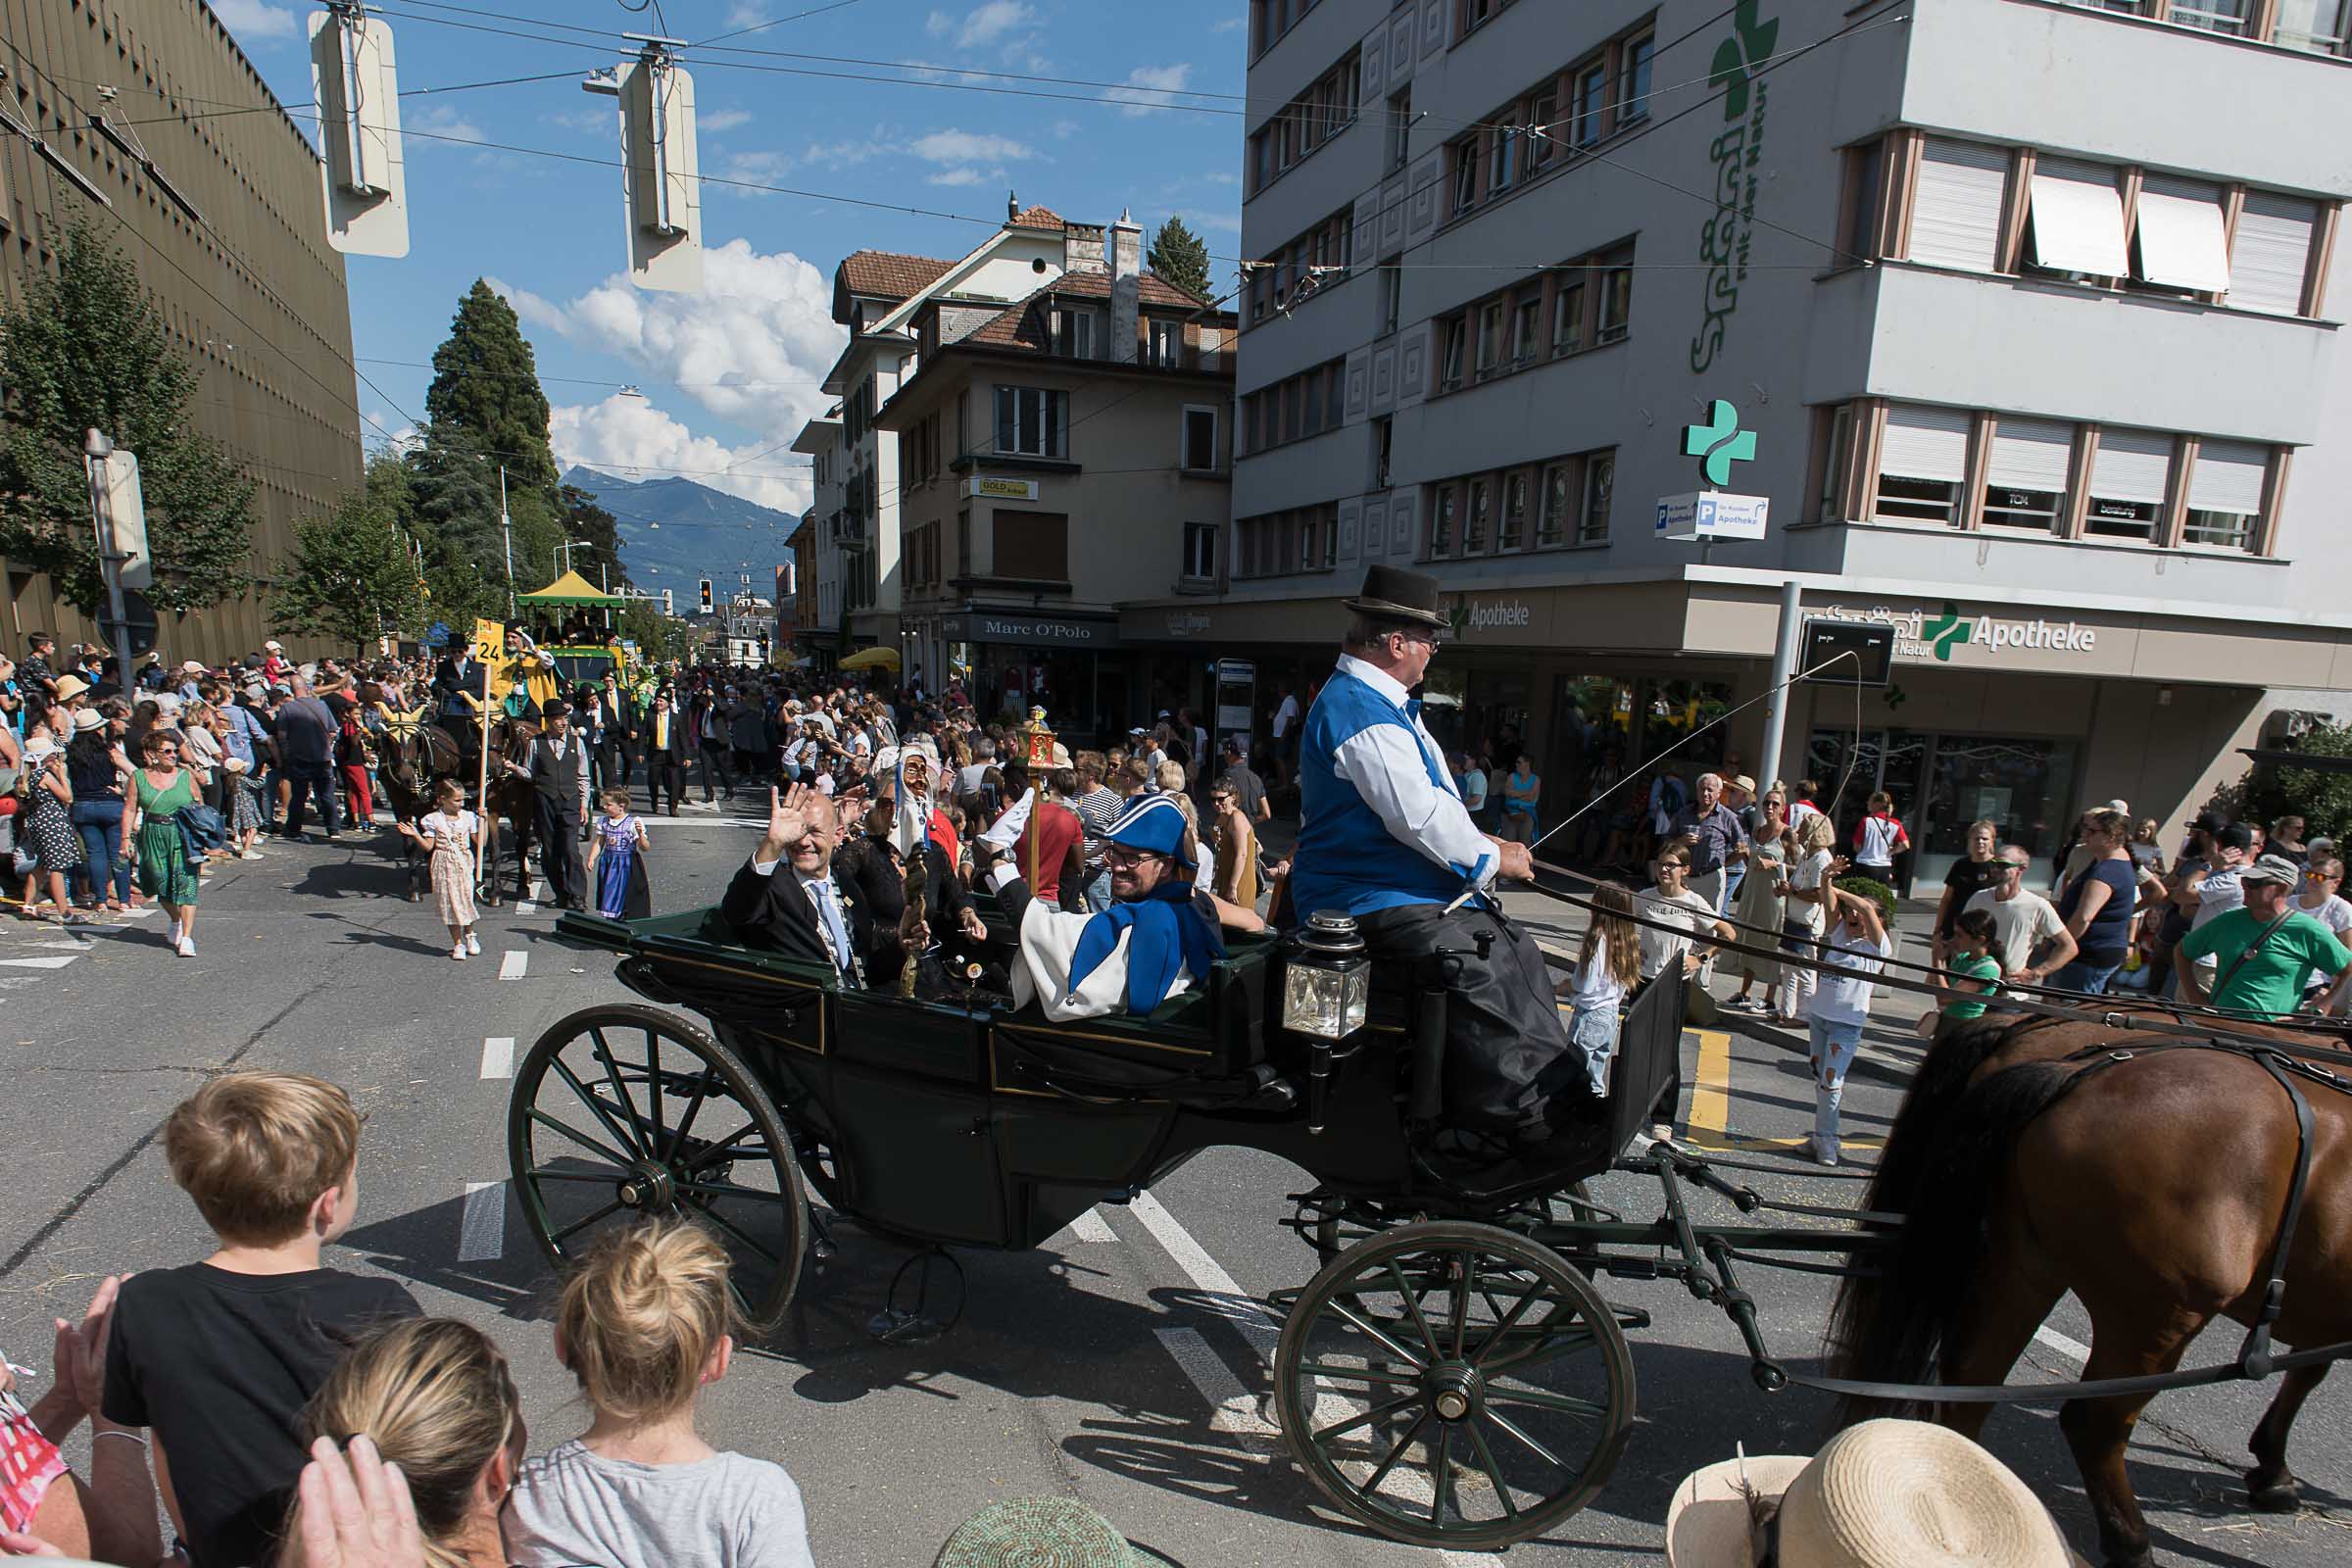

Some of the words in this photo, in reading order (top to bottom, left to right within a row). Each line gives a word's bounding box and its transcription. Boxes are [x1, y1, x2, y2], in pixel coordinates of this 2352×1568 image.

[1744, 81, 1768, 168] Natur
[1740, 173, 1757, 222] der
[1735, 231, 1751, 281] mit
[983, 481, 1006, 490] GOLD
[1700, 504, 1714, 520] P
[1718, 514, 1757, 525] Apotheke
[1470, 600, 1529, 631] Apotheke
[985, 620, 1030, 635] Marc
[1035, 624, 1091, 639] O'Polo
[1972, 615, 2095, 652] Apotheke
[480, 642, 499, 662] 24
[1898, 642, 1931, 657] Natur
